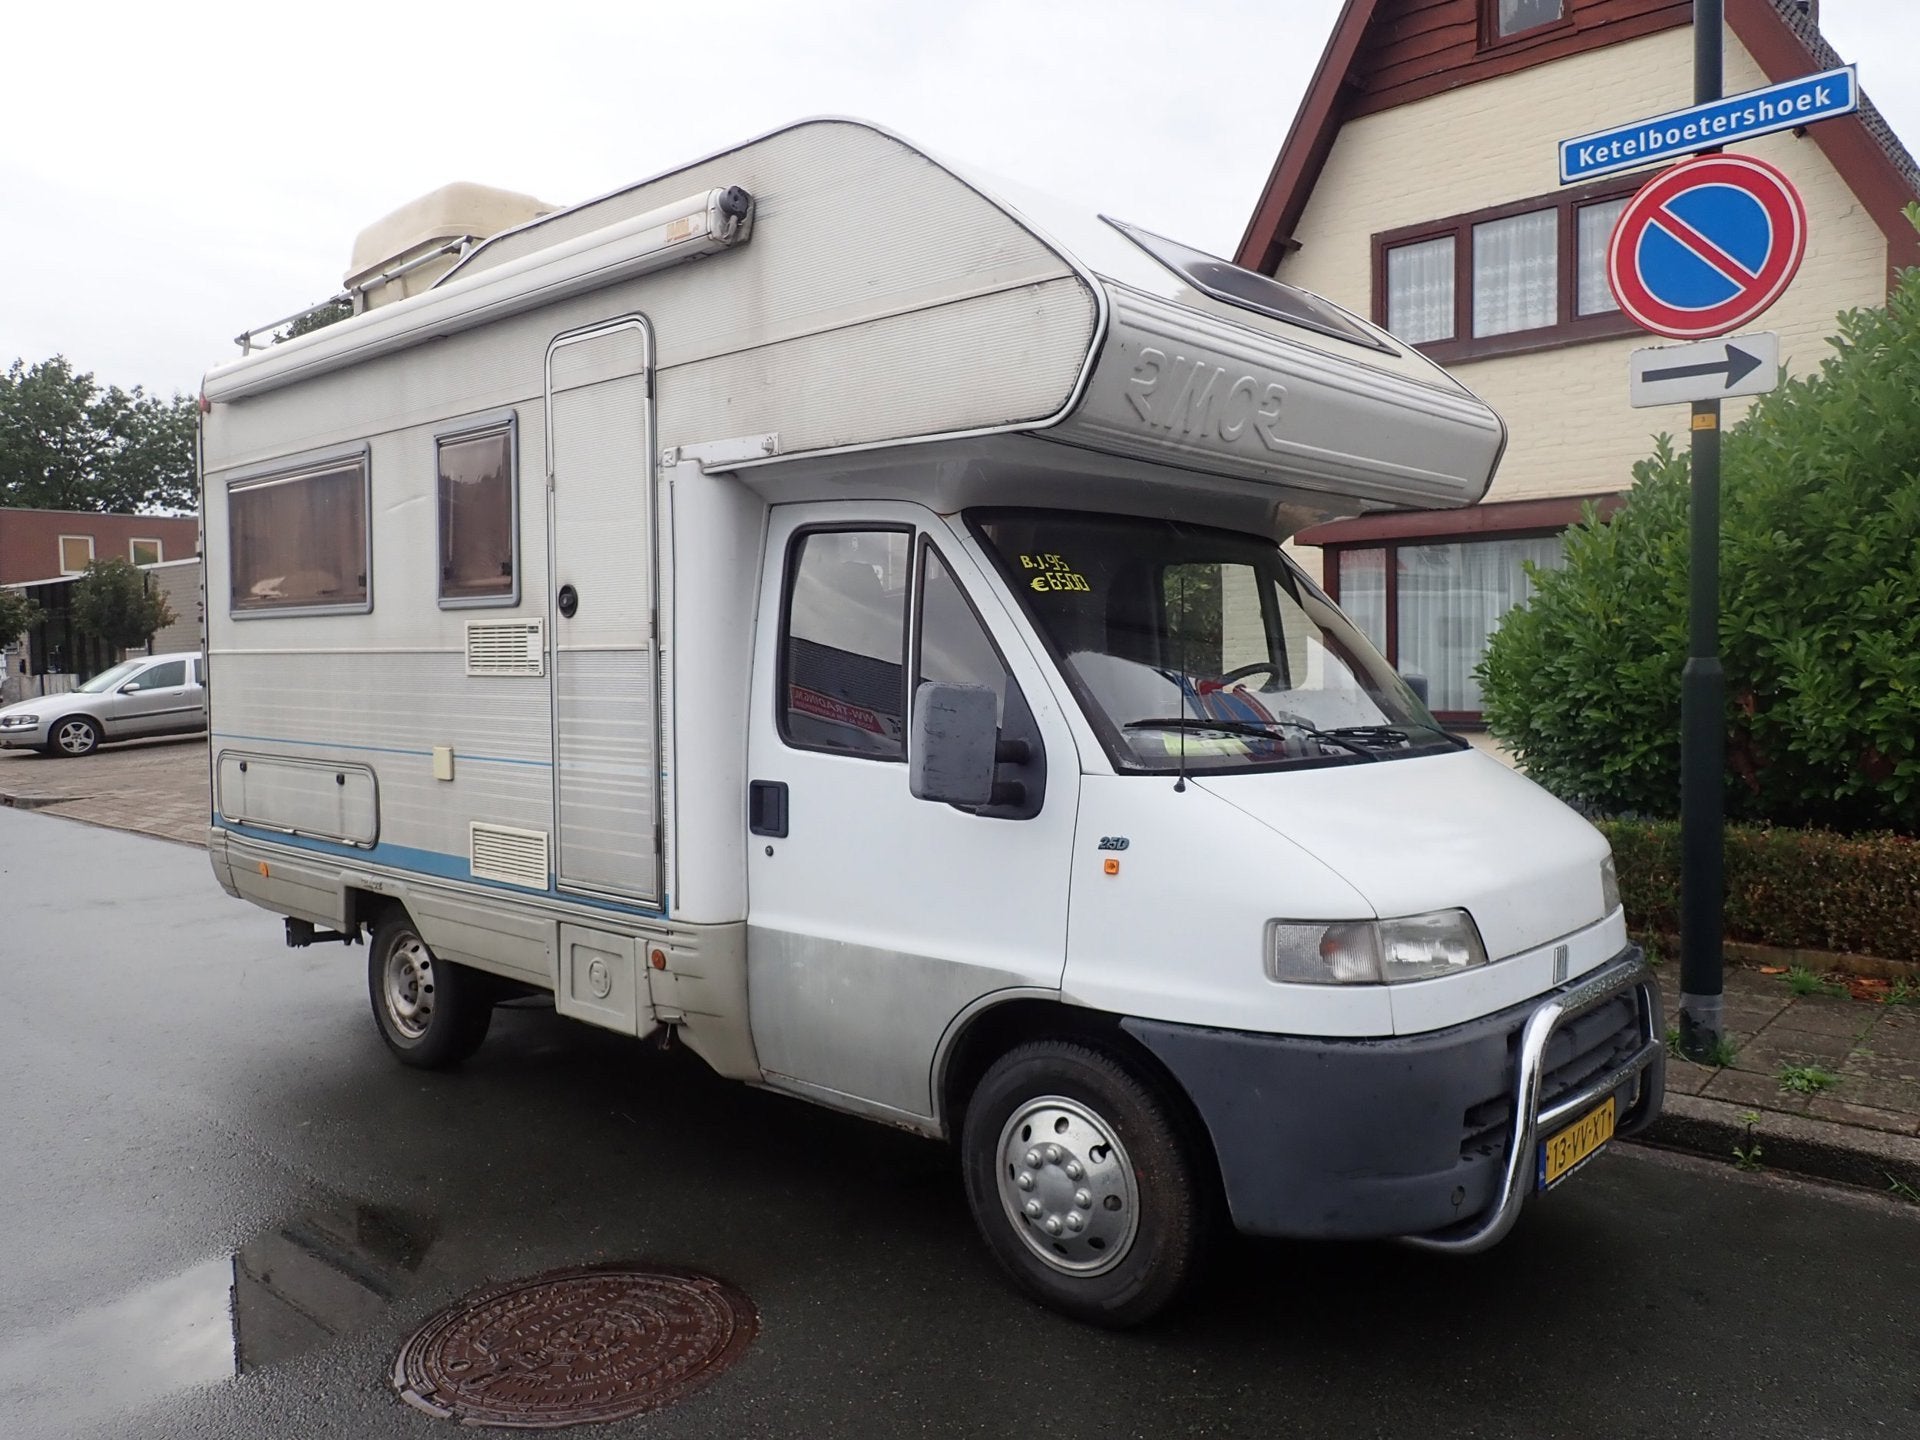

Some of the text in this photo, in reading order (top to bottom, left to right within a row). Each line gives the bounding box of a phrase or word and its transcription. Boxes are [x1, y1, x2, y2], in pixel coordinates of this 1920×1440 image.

[1578, 84, 1831, 167] Ketelboetershoek
[1124, 347, 1289, 451] RIMOR
[1553, 1107, 1607, 1173] 13-VV-XT
